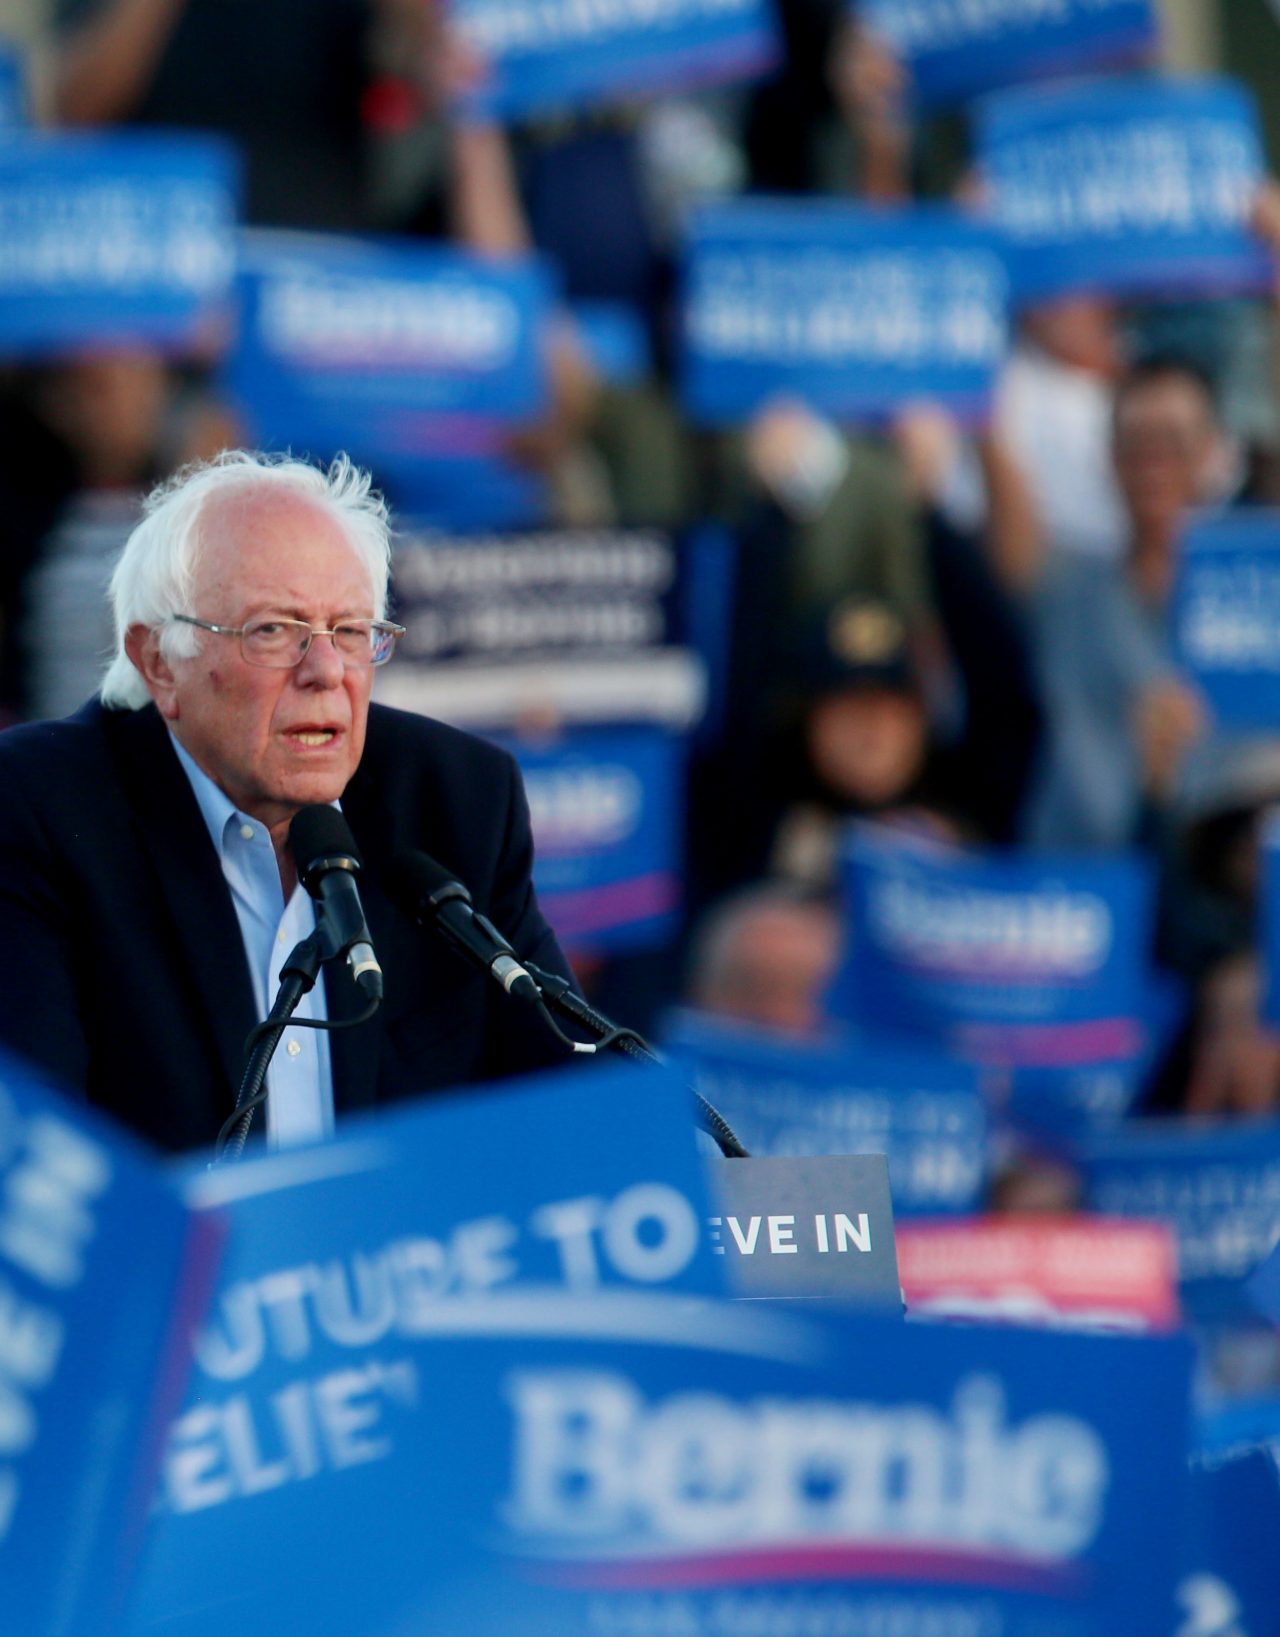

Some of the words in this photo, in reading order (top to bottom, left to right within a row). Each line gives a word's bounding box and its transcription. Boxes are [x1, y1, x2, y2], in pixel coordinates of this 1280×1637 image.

[532, 1182, 700, 1300] TO
[815, 1213, 871, 1252] IN
[503, 1367, 1110, 1562] Bernie
